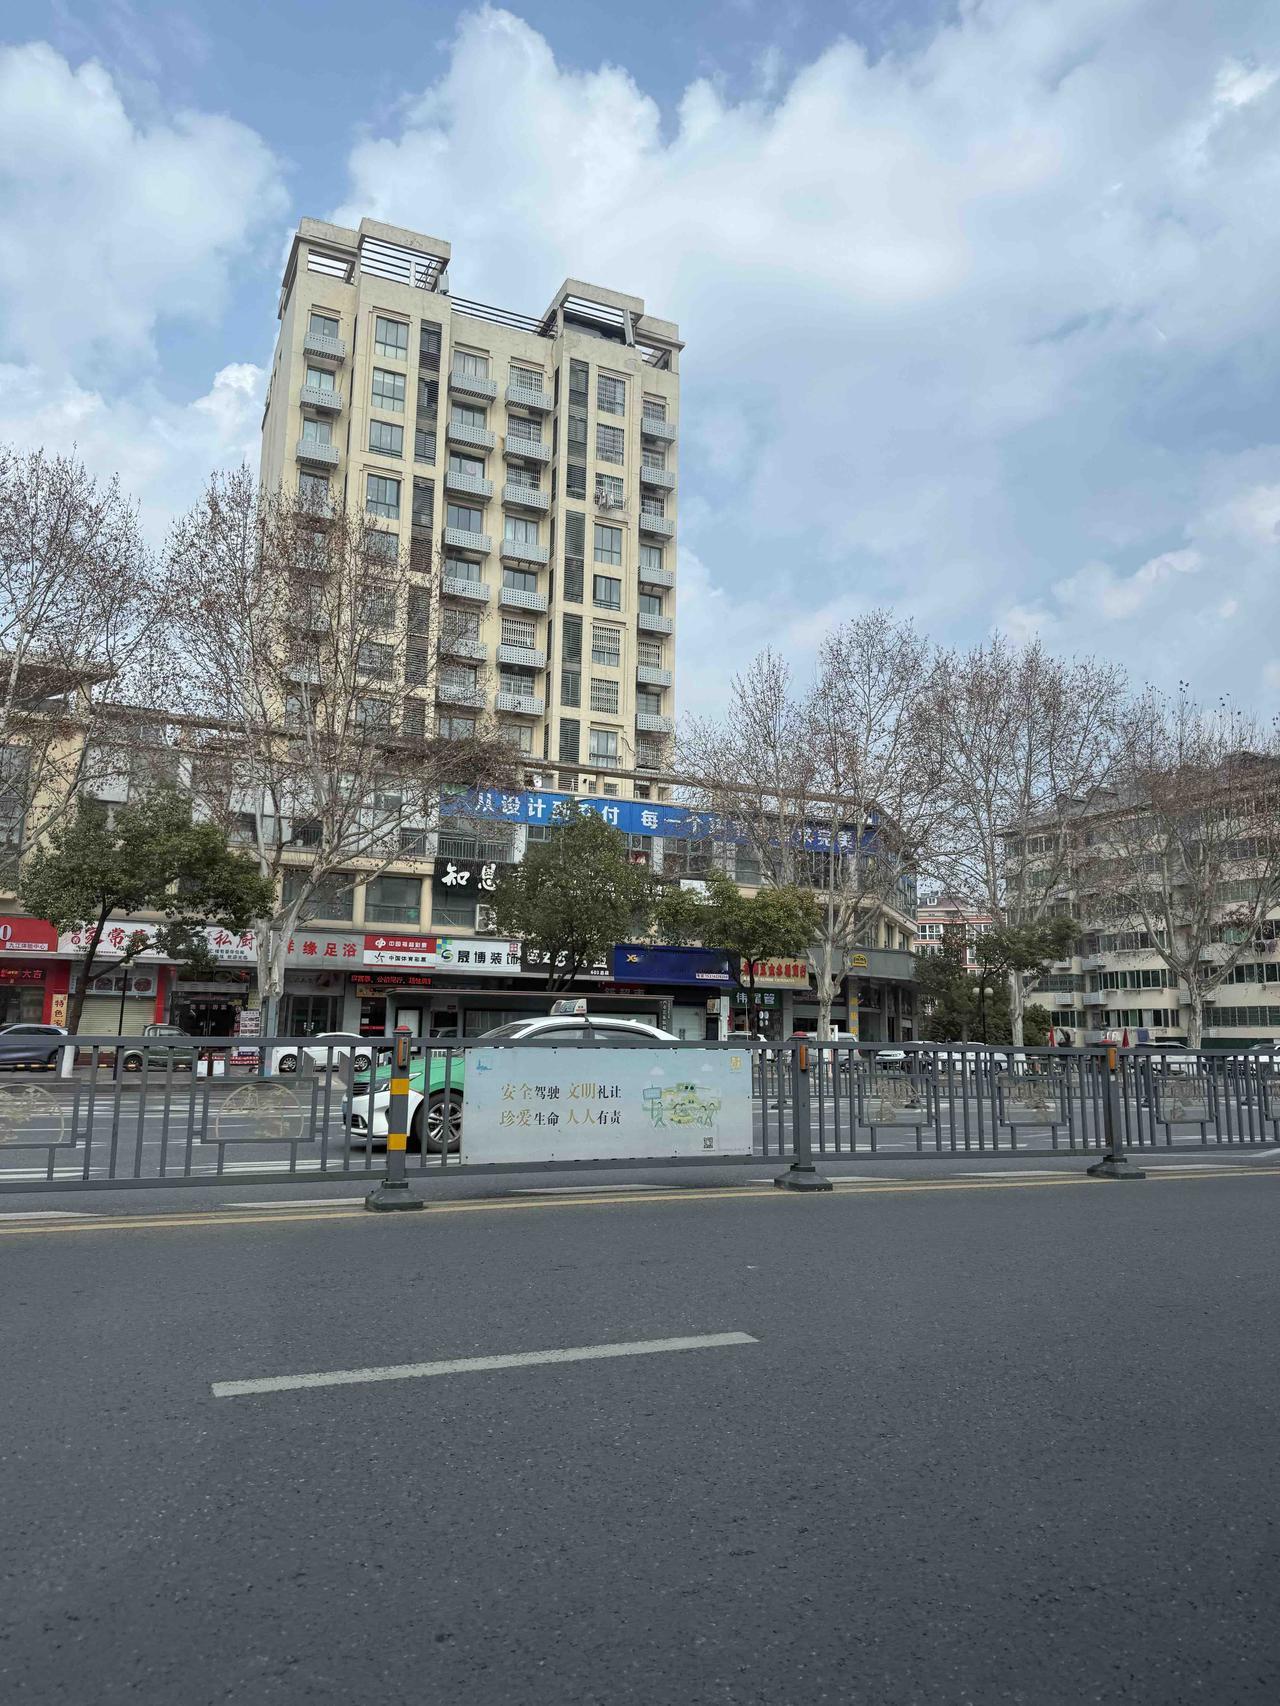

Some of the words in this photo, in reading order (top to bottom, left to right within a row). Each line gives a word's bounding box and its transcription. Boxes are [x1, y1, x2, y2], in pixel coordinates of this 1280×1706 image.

[475, 792, 620, 825] 从设计到交付
[388, 955, 427, 963] 中国体育彩票
[457, 950, 521, 966] 晟博装饰
[501, 1083, 560, 1101] 安全驾驶
[566, 1082, 622, 1101] 文明礼让
[500, 1108, 560, 1128] 珍爱生命
[566, 1108, 622, 1128] 人人有责
